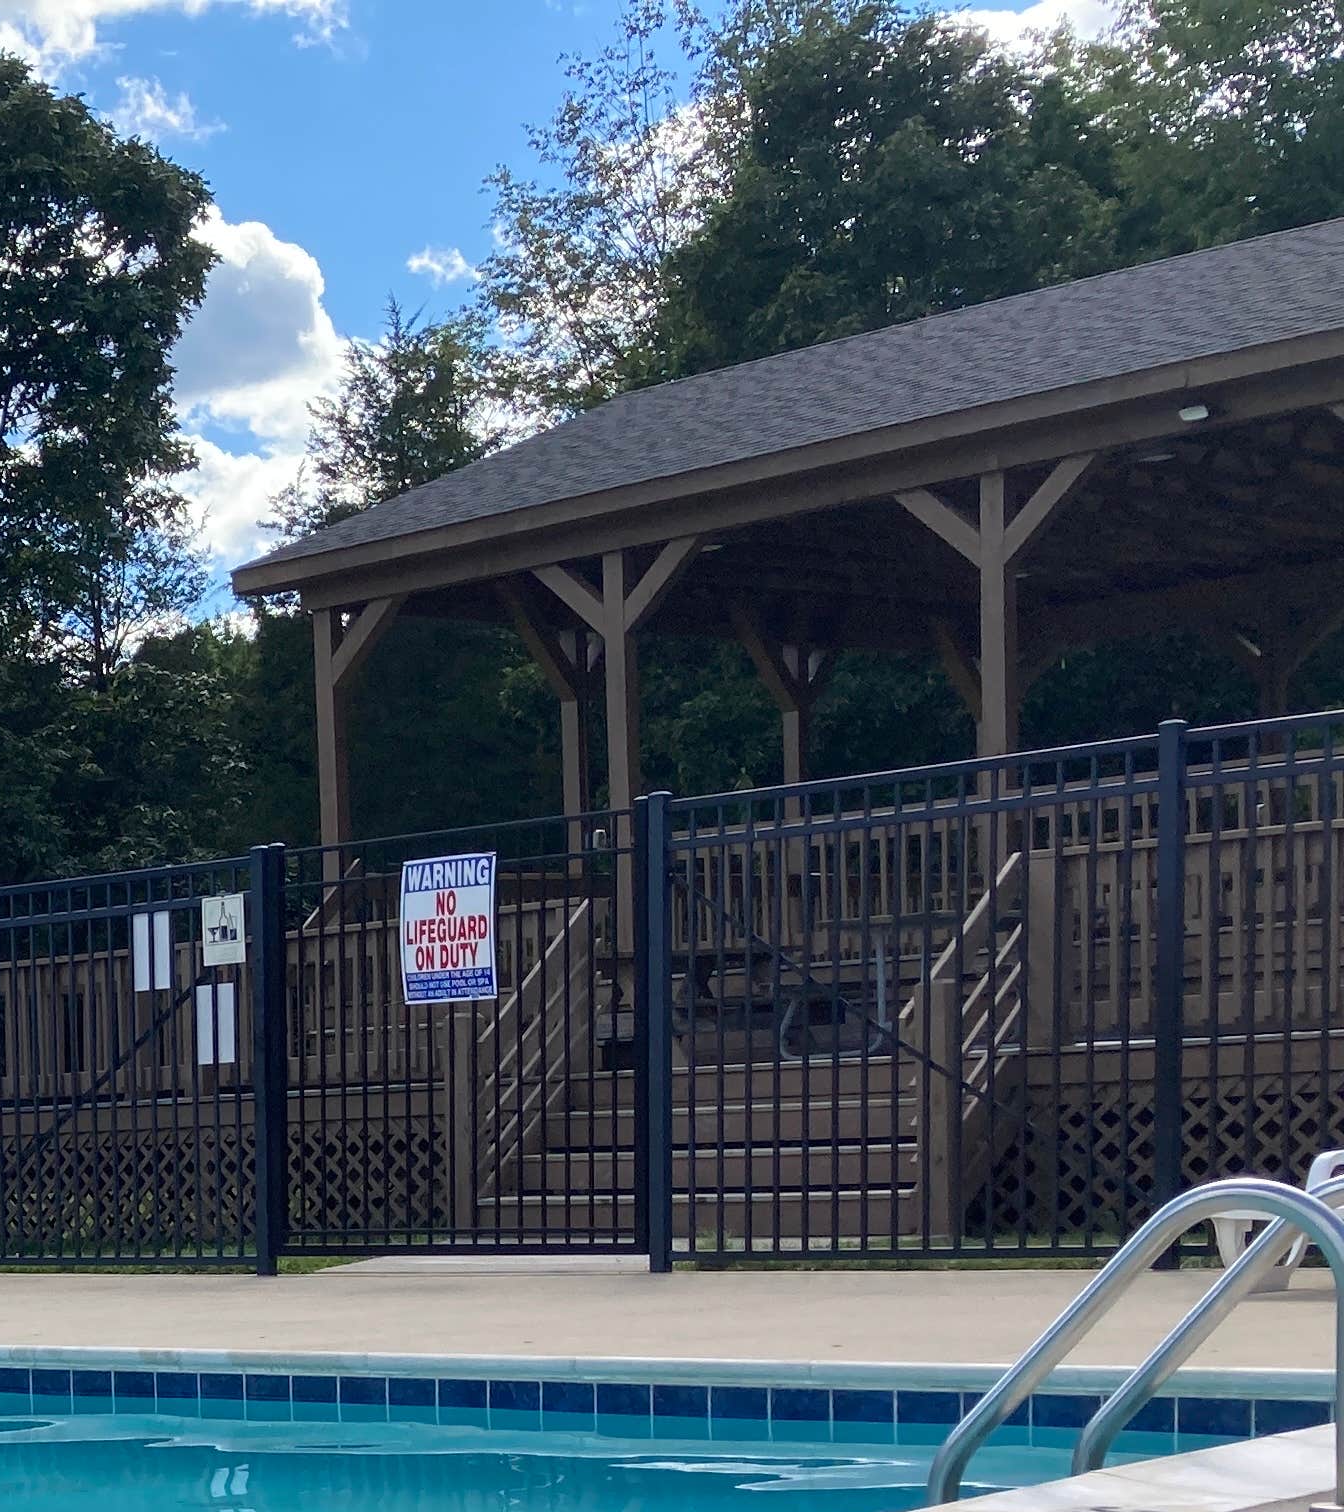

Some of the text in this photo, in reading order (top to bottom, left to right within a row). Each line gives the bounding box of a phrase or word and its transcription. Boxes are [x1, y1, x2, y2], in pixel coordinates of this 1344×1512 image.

[407, 858, 490, 892] WARNING
[436, 890, 456, 916] NO
[406, 914, 488, 945] LIFEGUARD
[415, 942, 479, 971] ON DUTY
[452, 979, 466, 988] POOL
[477, 977, 489, 986] SPA
